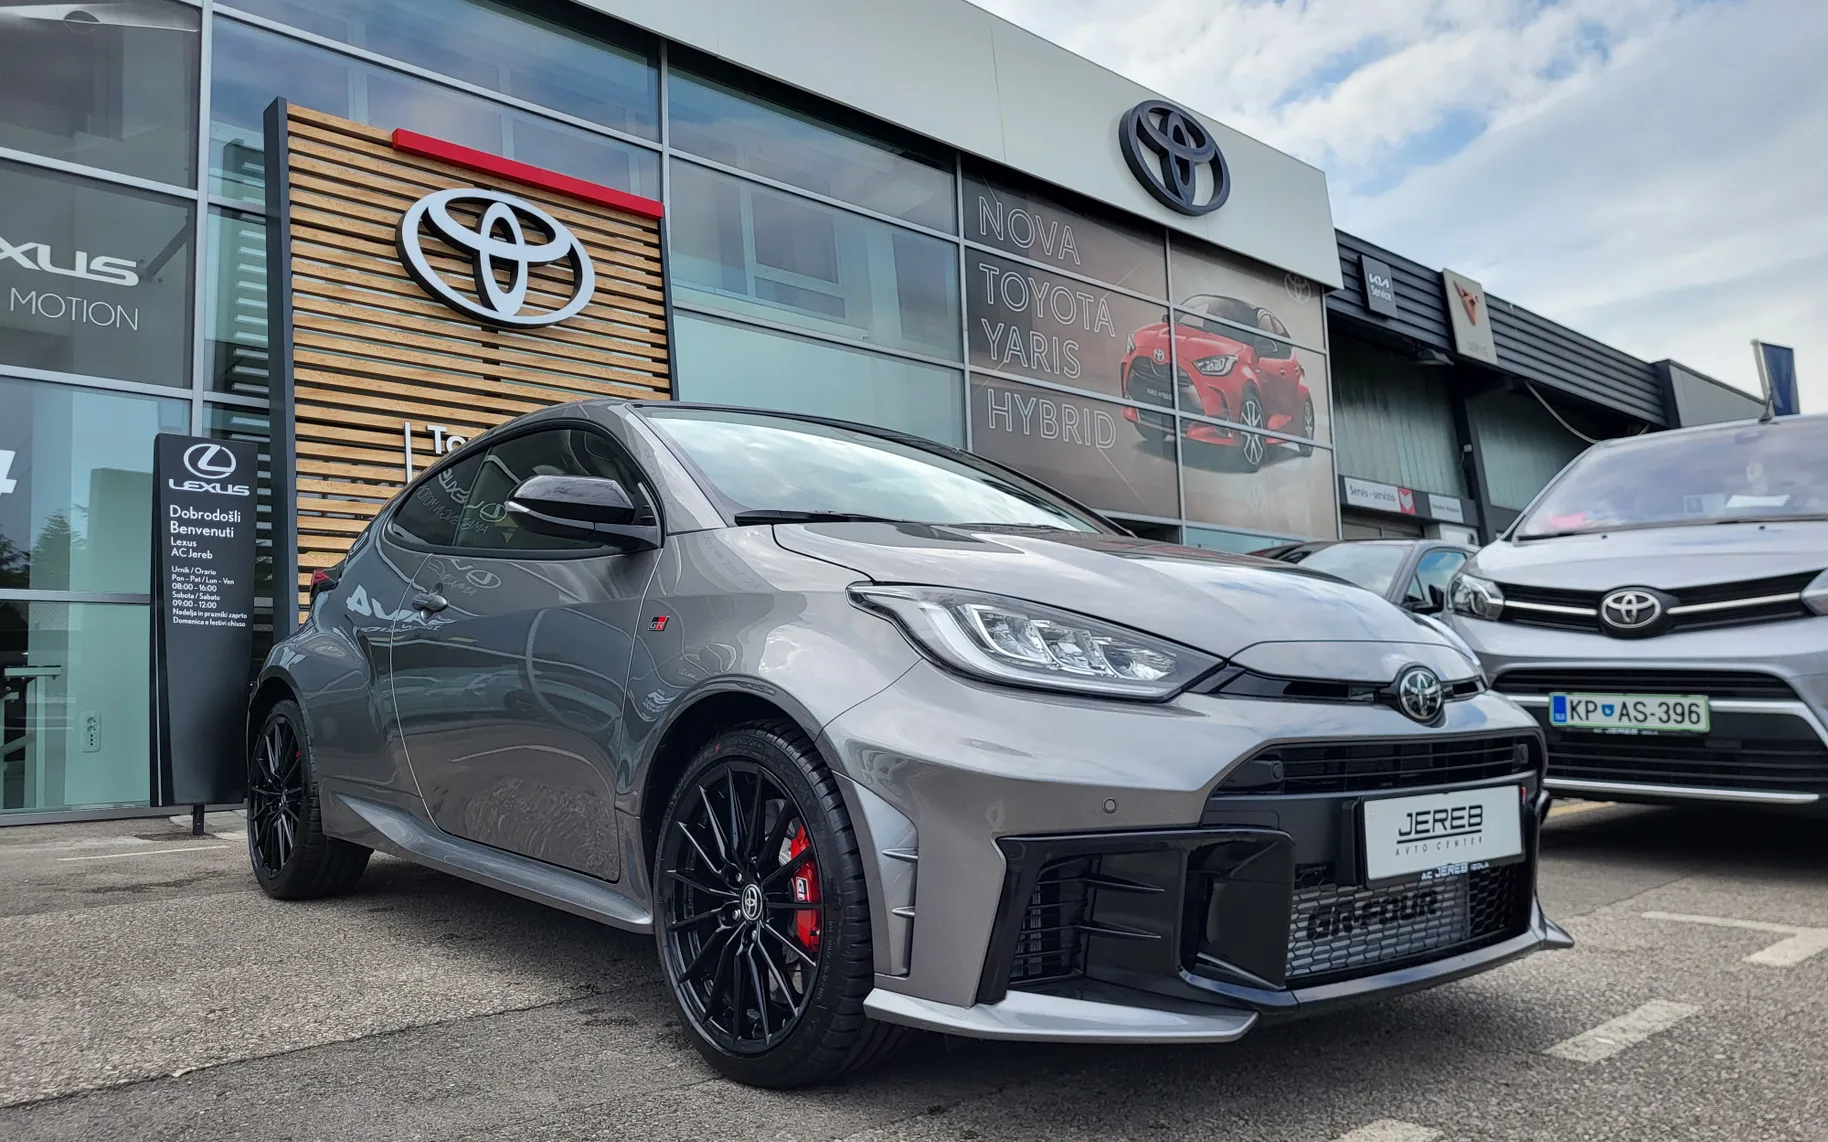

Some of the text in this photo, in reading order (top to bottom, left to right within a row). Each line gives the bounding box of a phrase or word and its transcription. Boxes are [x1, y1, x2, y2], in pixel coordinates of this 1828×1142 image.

[978, 195, 1081, 265] NOVA
[9, 287, 139, 331] MOTION
[979, 263, 1115, 338] TOYOTA
[981, 318, 1081, 380] YARIS
[987, 388, 1117, 450] HYBRID
[426, 424, 471, 455] To
[168, 479, 250, 496] LEXUS
[169, 504, 241, 523] Dobrodošli
[170, 520, 234, 538] Benvenuti
[170, 536, 198, 547] Lexus
[171, 547, 213, 559] AC Jereb
[194, 567, 217, 575] Orario
[205, 576, 218, 584] Lun
[171, 582, 194, 590] 08:00
[198, 584, 218, 592] 16:00
[172, 590, 195, 599] Sobota
[199, 592, 221, 601] Sabato
[172, 599, 194, 607] 09:00
[198, 601, 218, 609] 12:00
[1569, 699, 1701, 725] KP AS-396
[1398, 804, 1483, 837] JEREB
[1395, 835, 1482, 857] AVTO CENTER
[1421, 871, 1433, 881] AC
[1435, 862, 1469, 878] JEREB
